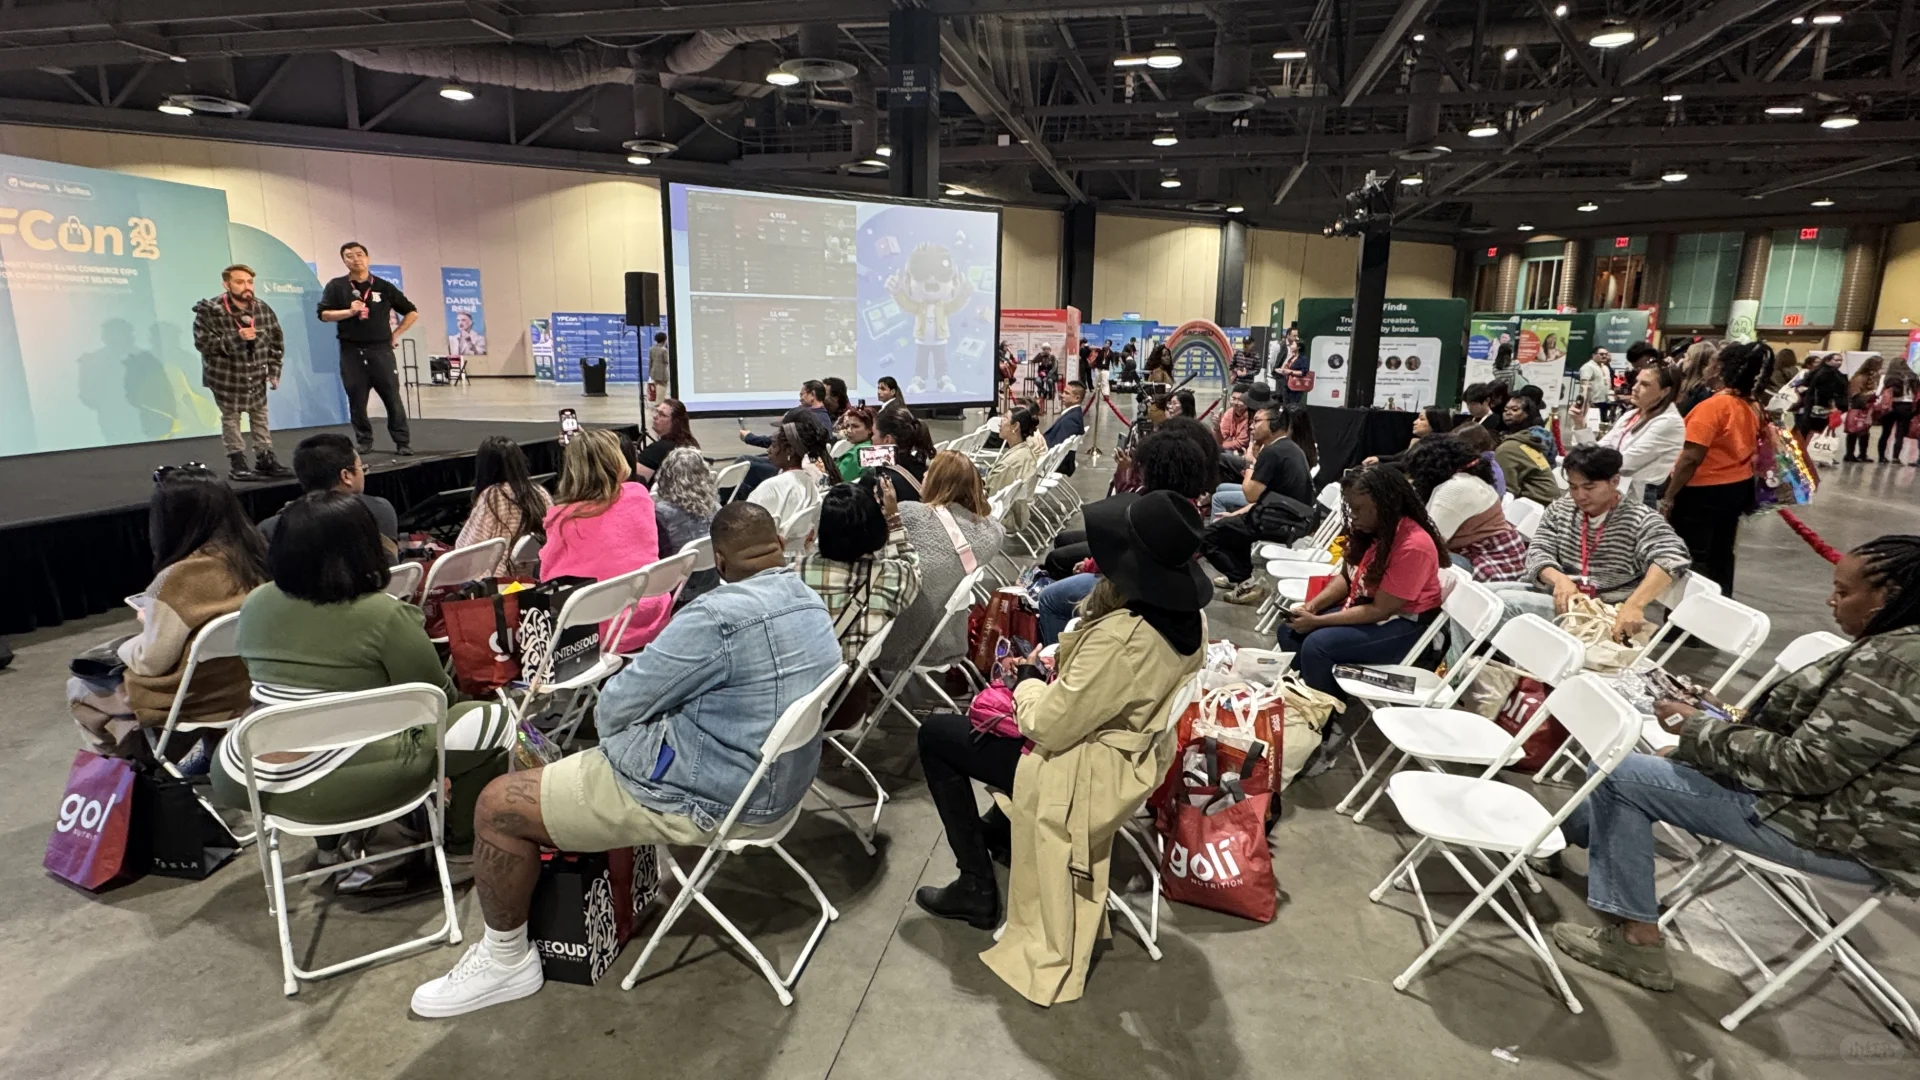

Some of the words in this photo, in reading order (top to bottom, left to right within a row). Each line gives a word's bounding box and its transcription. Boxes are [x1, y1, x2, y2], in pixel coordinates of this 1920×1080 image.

[446, 279, 478, 287] YFCon
[446, 296, 481, 305] DANIEL
[1392, 325, 1419, 333] brands
[1168, 836, 1241, 881] goli
[1190, 877, 1244, 890] NUTRITION
